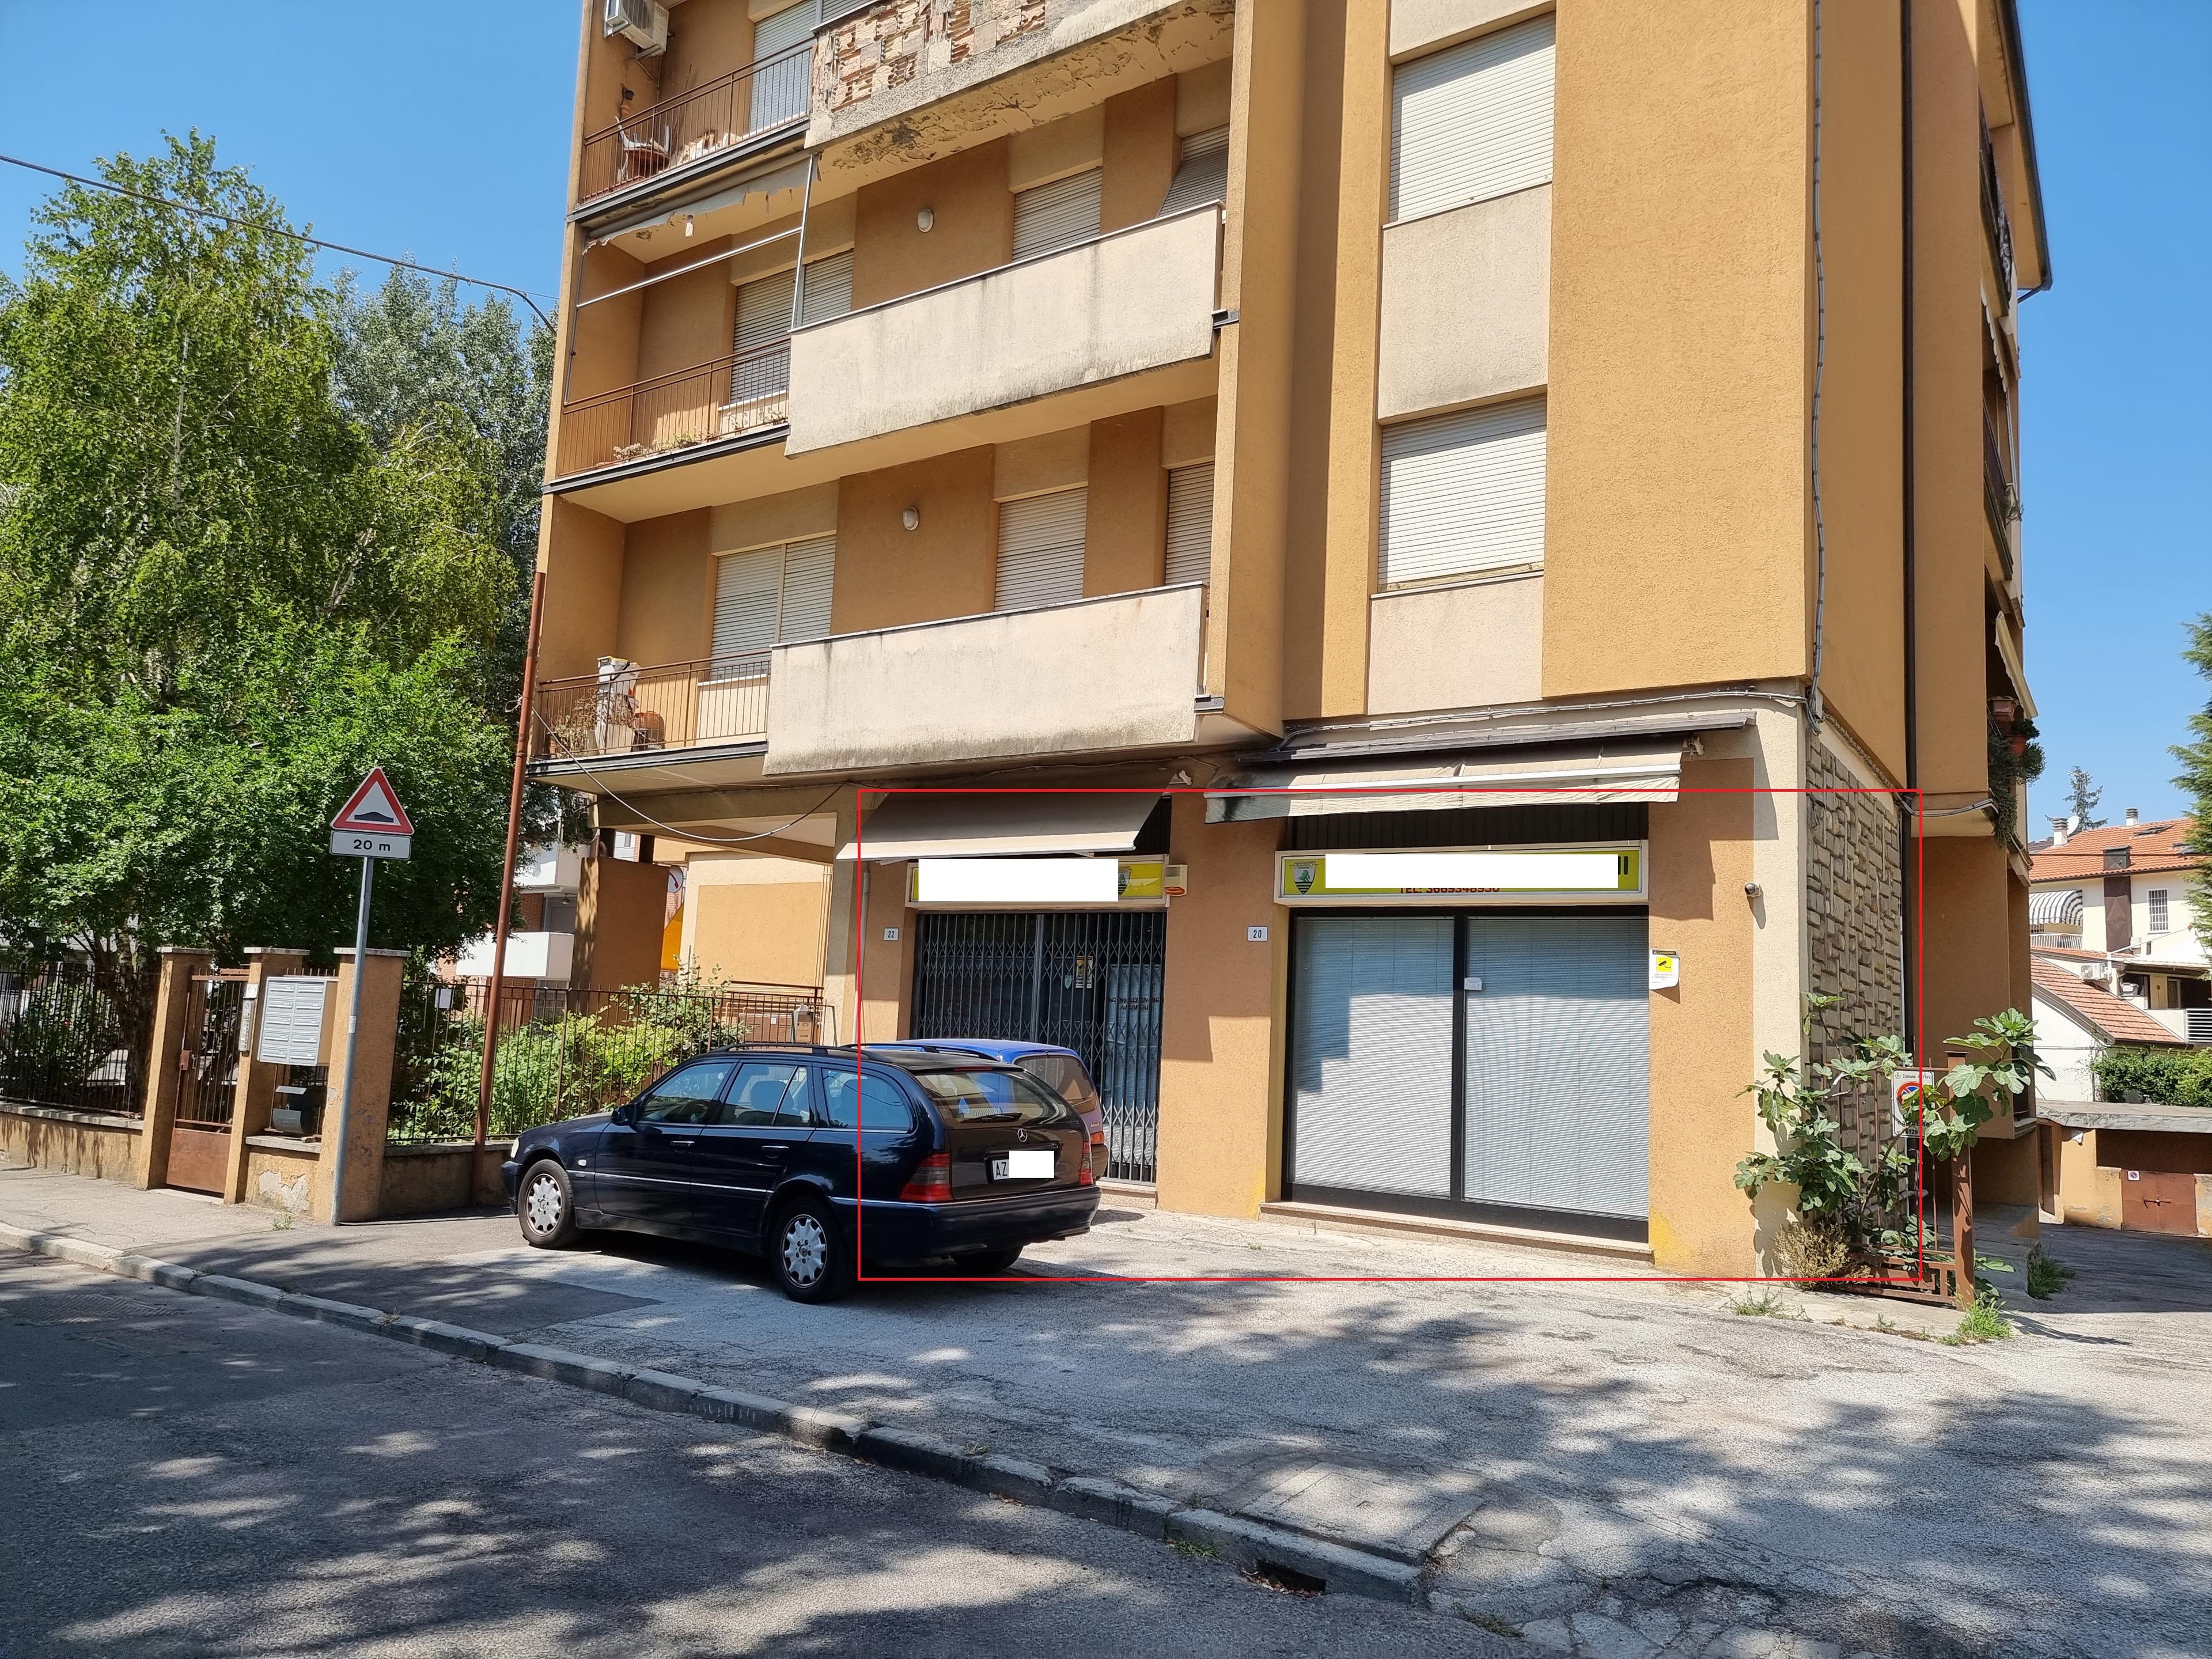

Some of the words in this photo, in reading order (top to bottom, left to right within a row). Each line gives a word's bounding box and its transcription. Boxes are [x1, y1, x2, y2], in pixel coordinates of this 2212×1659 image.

[354, 839, 373, 850] 20
[379, 843, 391, 851] m
[1253, 930, 1262, 938] 20
